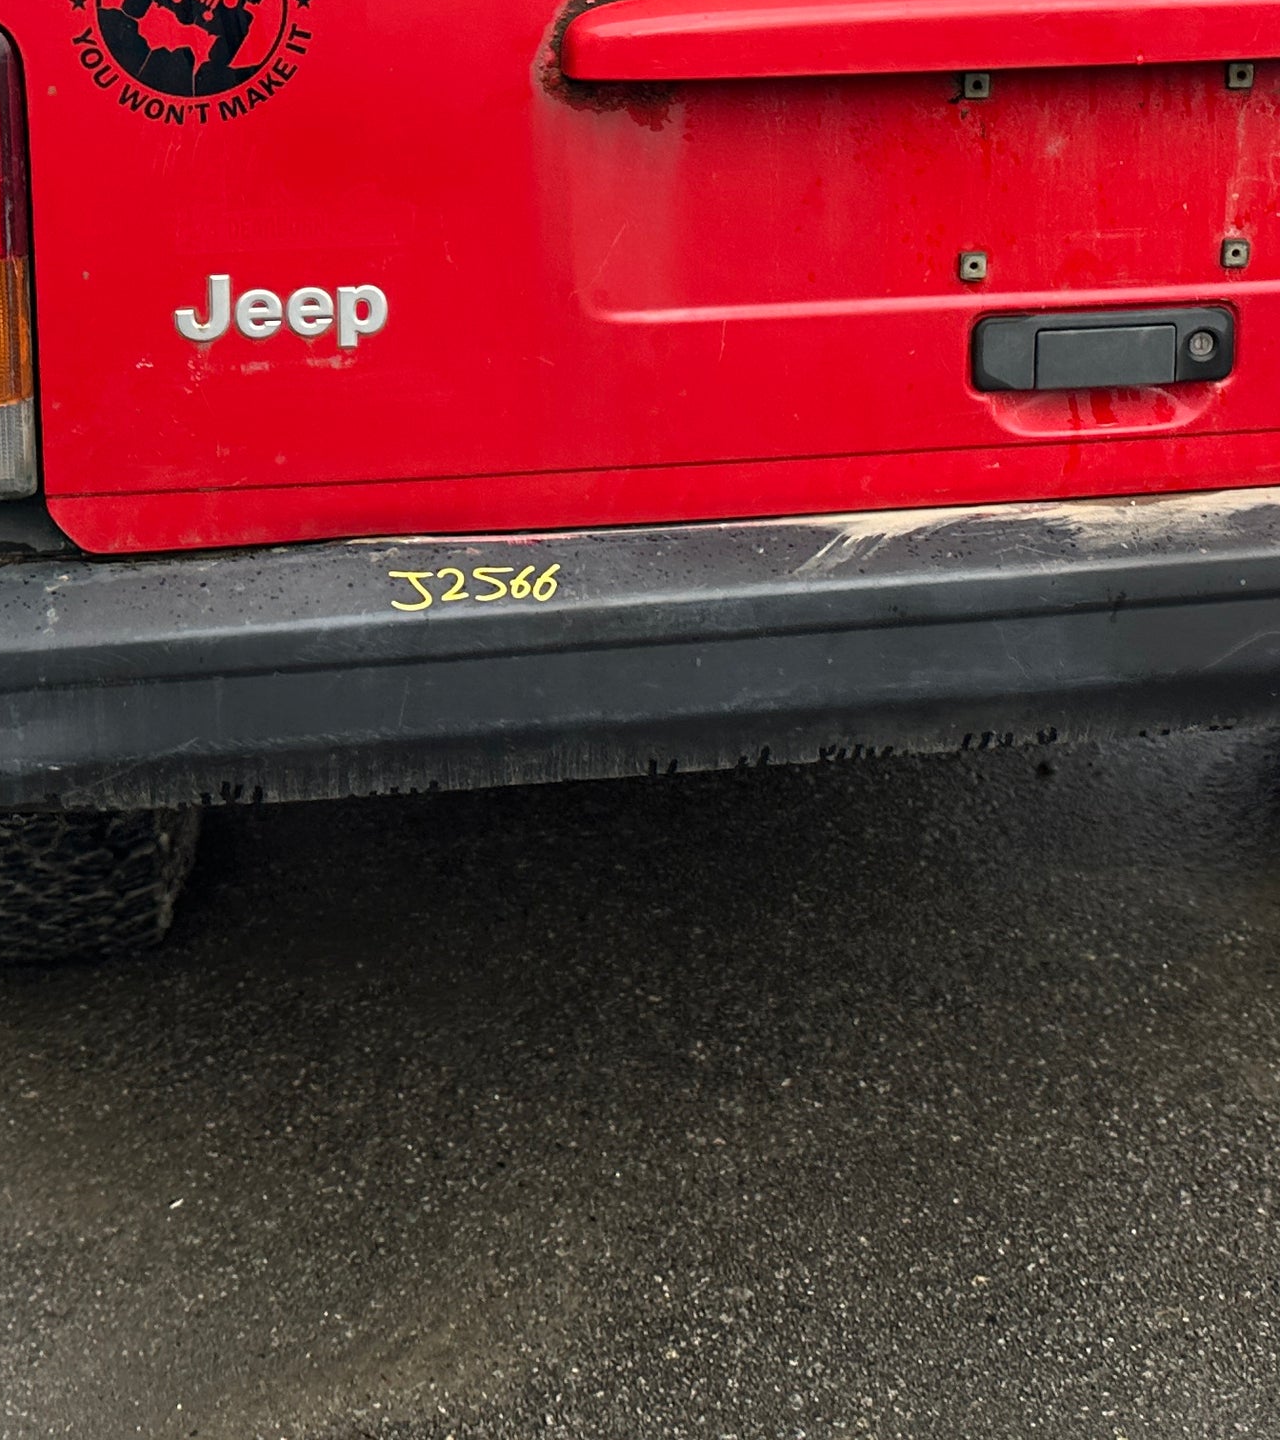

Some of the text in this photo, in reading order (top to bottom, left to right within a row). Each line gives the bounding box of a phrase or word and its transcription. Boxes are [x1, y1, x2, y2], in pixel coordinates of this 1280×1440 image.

[71, 23, 313, 126] YOU WON'T MAKE IT
[175, 274, 389, 348] Jeep
[388, 563, 561, 611] J2566
